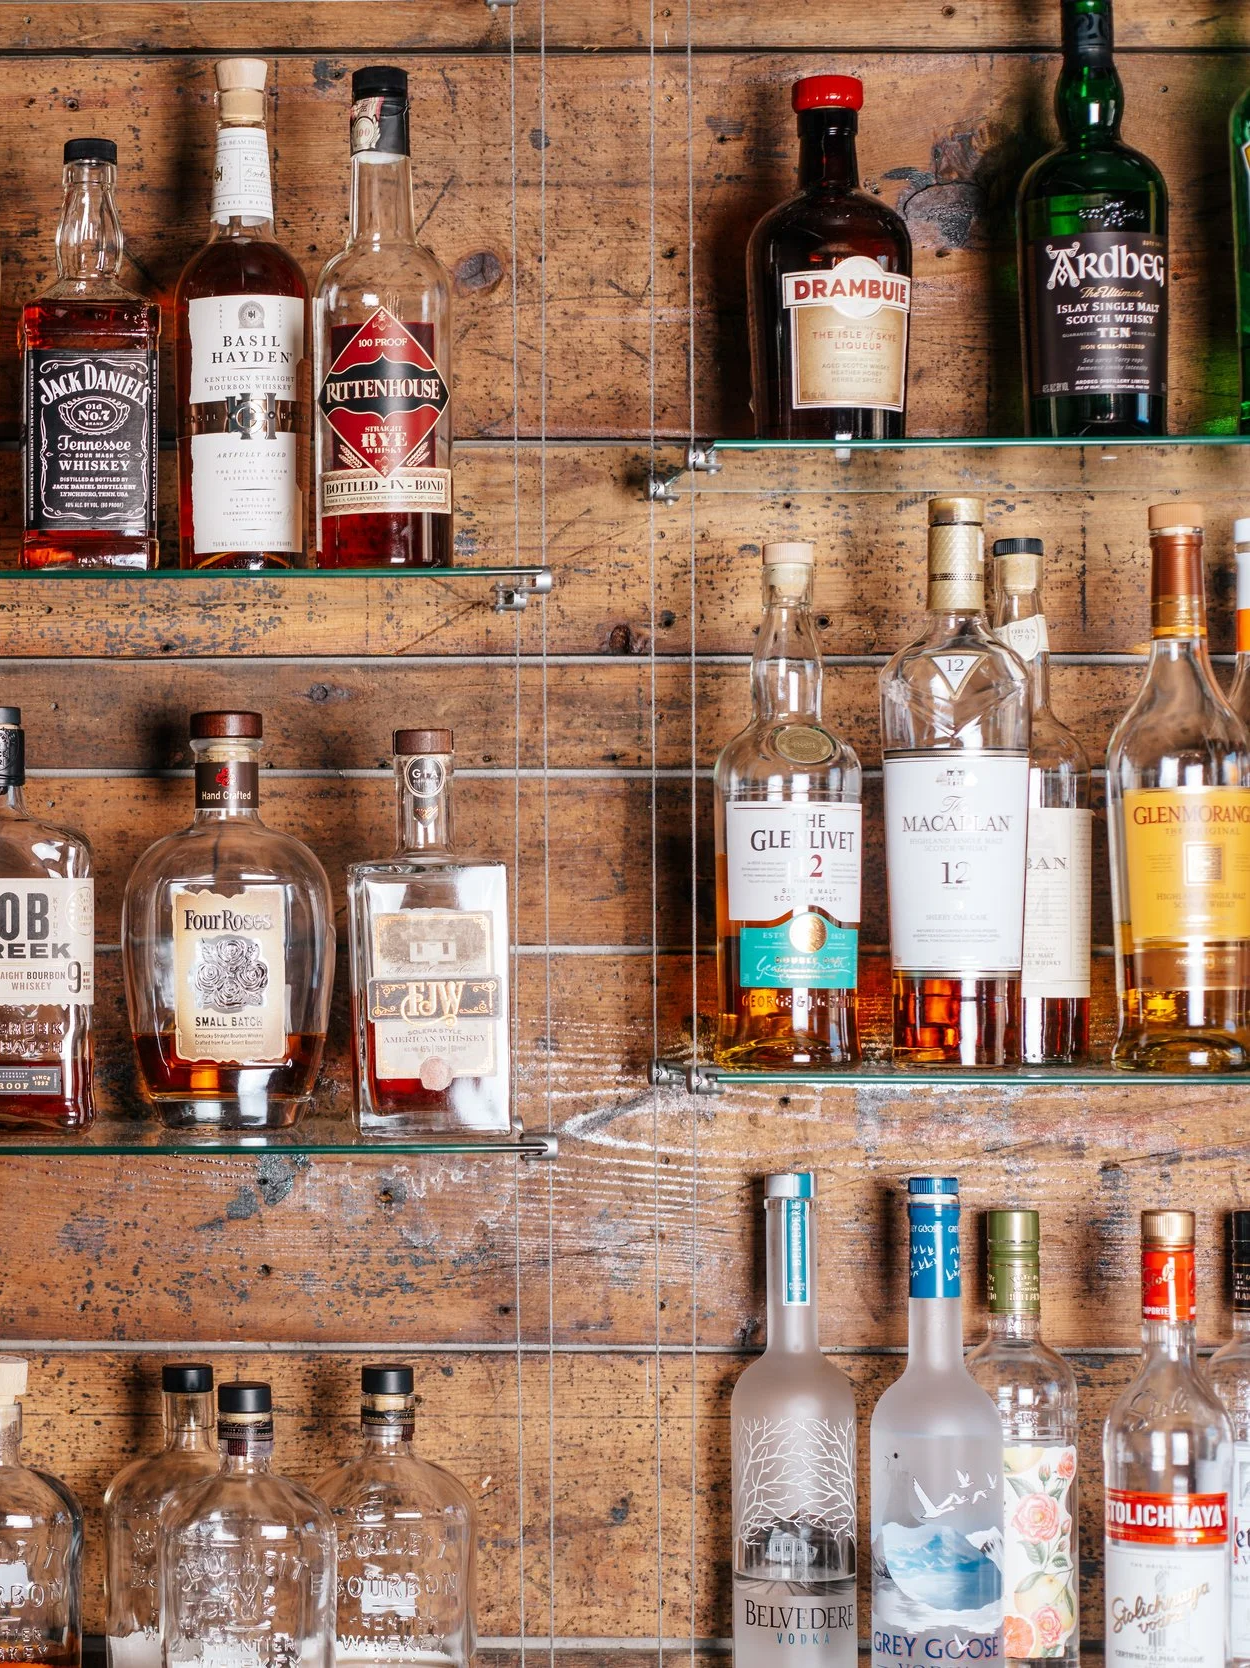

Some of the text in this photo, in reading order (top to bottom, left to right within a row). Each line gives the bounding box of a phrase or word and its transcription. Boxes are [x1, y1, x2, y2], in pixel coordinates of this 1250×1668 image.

[794, 279, 907, 304] DRAMBUIE
[1056, 301, 1160, 315] ISLAY SINGLE MALT
[1065, 314, 1155, 325] SCOTCH WHISKY
[222, 335, 281, 347] BASIL
[358, 337, 408, 348] 100 PROOF
[812, 330, 898, 343] THE ISLE of SKYE
[834, 341, 883, 351] LIQUEUR
[211, 351, 290, 364] HAYDEN
[38, 363, 151, 406] JACK DANIEL'S
[204, 375, 295, 383] KENTUCKY STRAIGHT
[325, 378, 440, 404] RITTENHOUSE
[364, 425, 404, 433] STRAIGHT
[57, 434, 131, 451] Tennessee
[360, 432, 408, 448] RYE
[365, 446, 402, 454] WHISKY
[58, 460, 131, 471] WHISKEY
[325, 478, 379, 496] BOTTLED
[414, 477, 444, 493] BOND
[945, 657, 965, 673] 12
[202, 790, 252, 801] Hand Crafted
[750, 829, 855, 853] GLELIVET
[1025, 857, 1068, 870] BAN
[941, 861, 972, 885] 12
[183, 909, 272, 932] Four Roses
[26, 970, 66, 980] BOURBON
[67, 960, 82, 994] 9
[11, 982, 52, 991] WHISKEY
[195, 1016, 263, 1027] SMALL BATCH
[383, 1034, 487, 1044] AMERICAN WHISKEY
[744, 1598, 854, 1631] BELVEDERE
[776, 1632, 830, 1645] VODKA
[873, 1631, 999, 1659] GREY GOOSE
